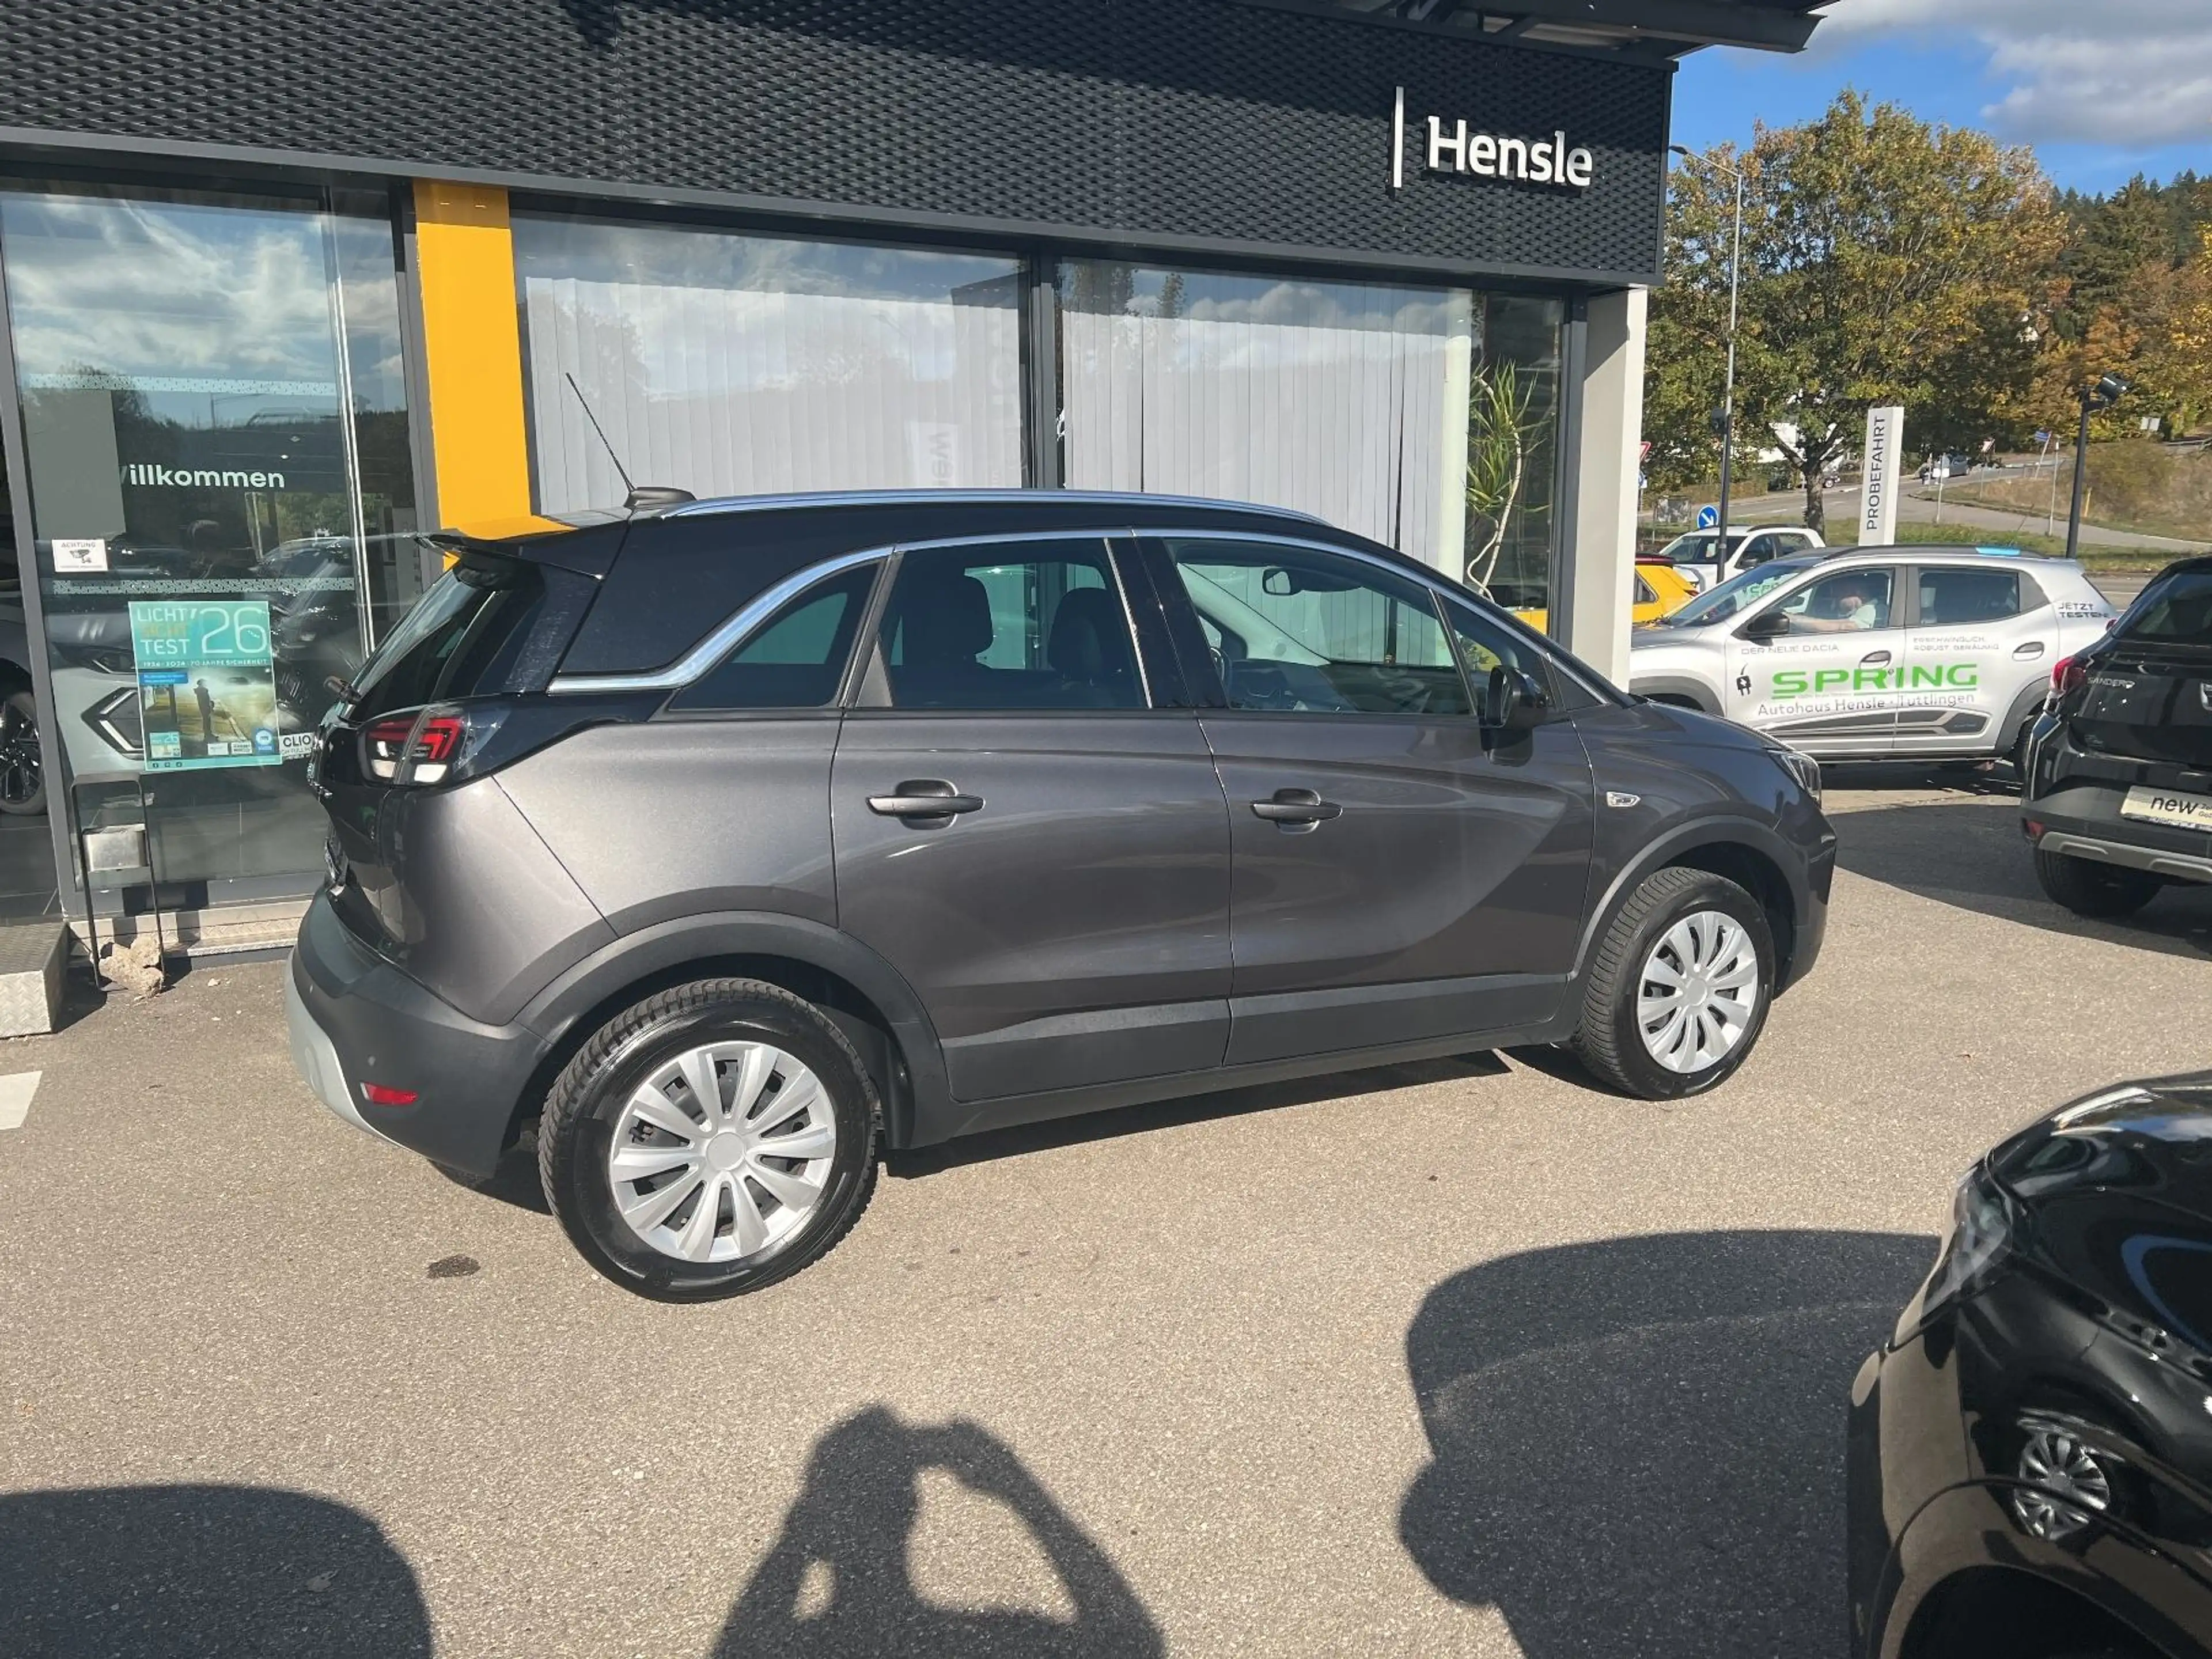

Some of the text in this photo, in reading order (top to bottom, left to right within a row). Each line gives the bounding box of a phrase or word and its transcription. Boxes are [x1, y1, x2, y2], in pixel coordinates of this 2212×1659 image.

[1428, 115, 1593, 187] Hensle
[118, 464, 285, 488] illkommen
[1867, 415, 1886, 531] PROBEFAHRT
[137, 608, 185, 622] LICHT
[2058, 602, 2093, 611] JETZT
[140, 638, 190, 655] TEST
[1768, 646, 1800, 654] NEUE
[1802, 643, 1839, 652] DACIA
[1772, 663, 1977, 696] SPRING
[1758, 694, 1975, 717] Autohaus Hensle Tuttlingen
[283, 734, 312, 747] CLIO
[2150, 797, 2199, 815] new
